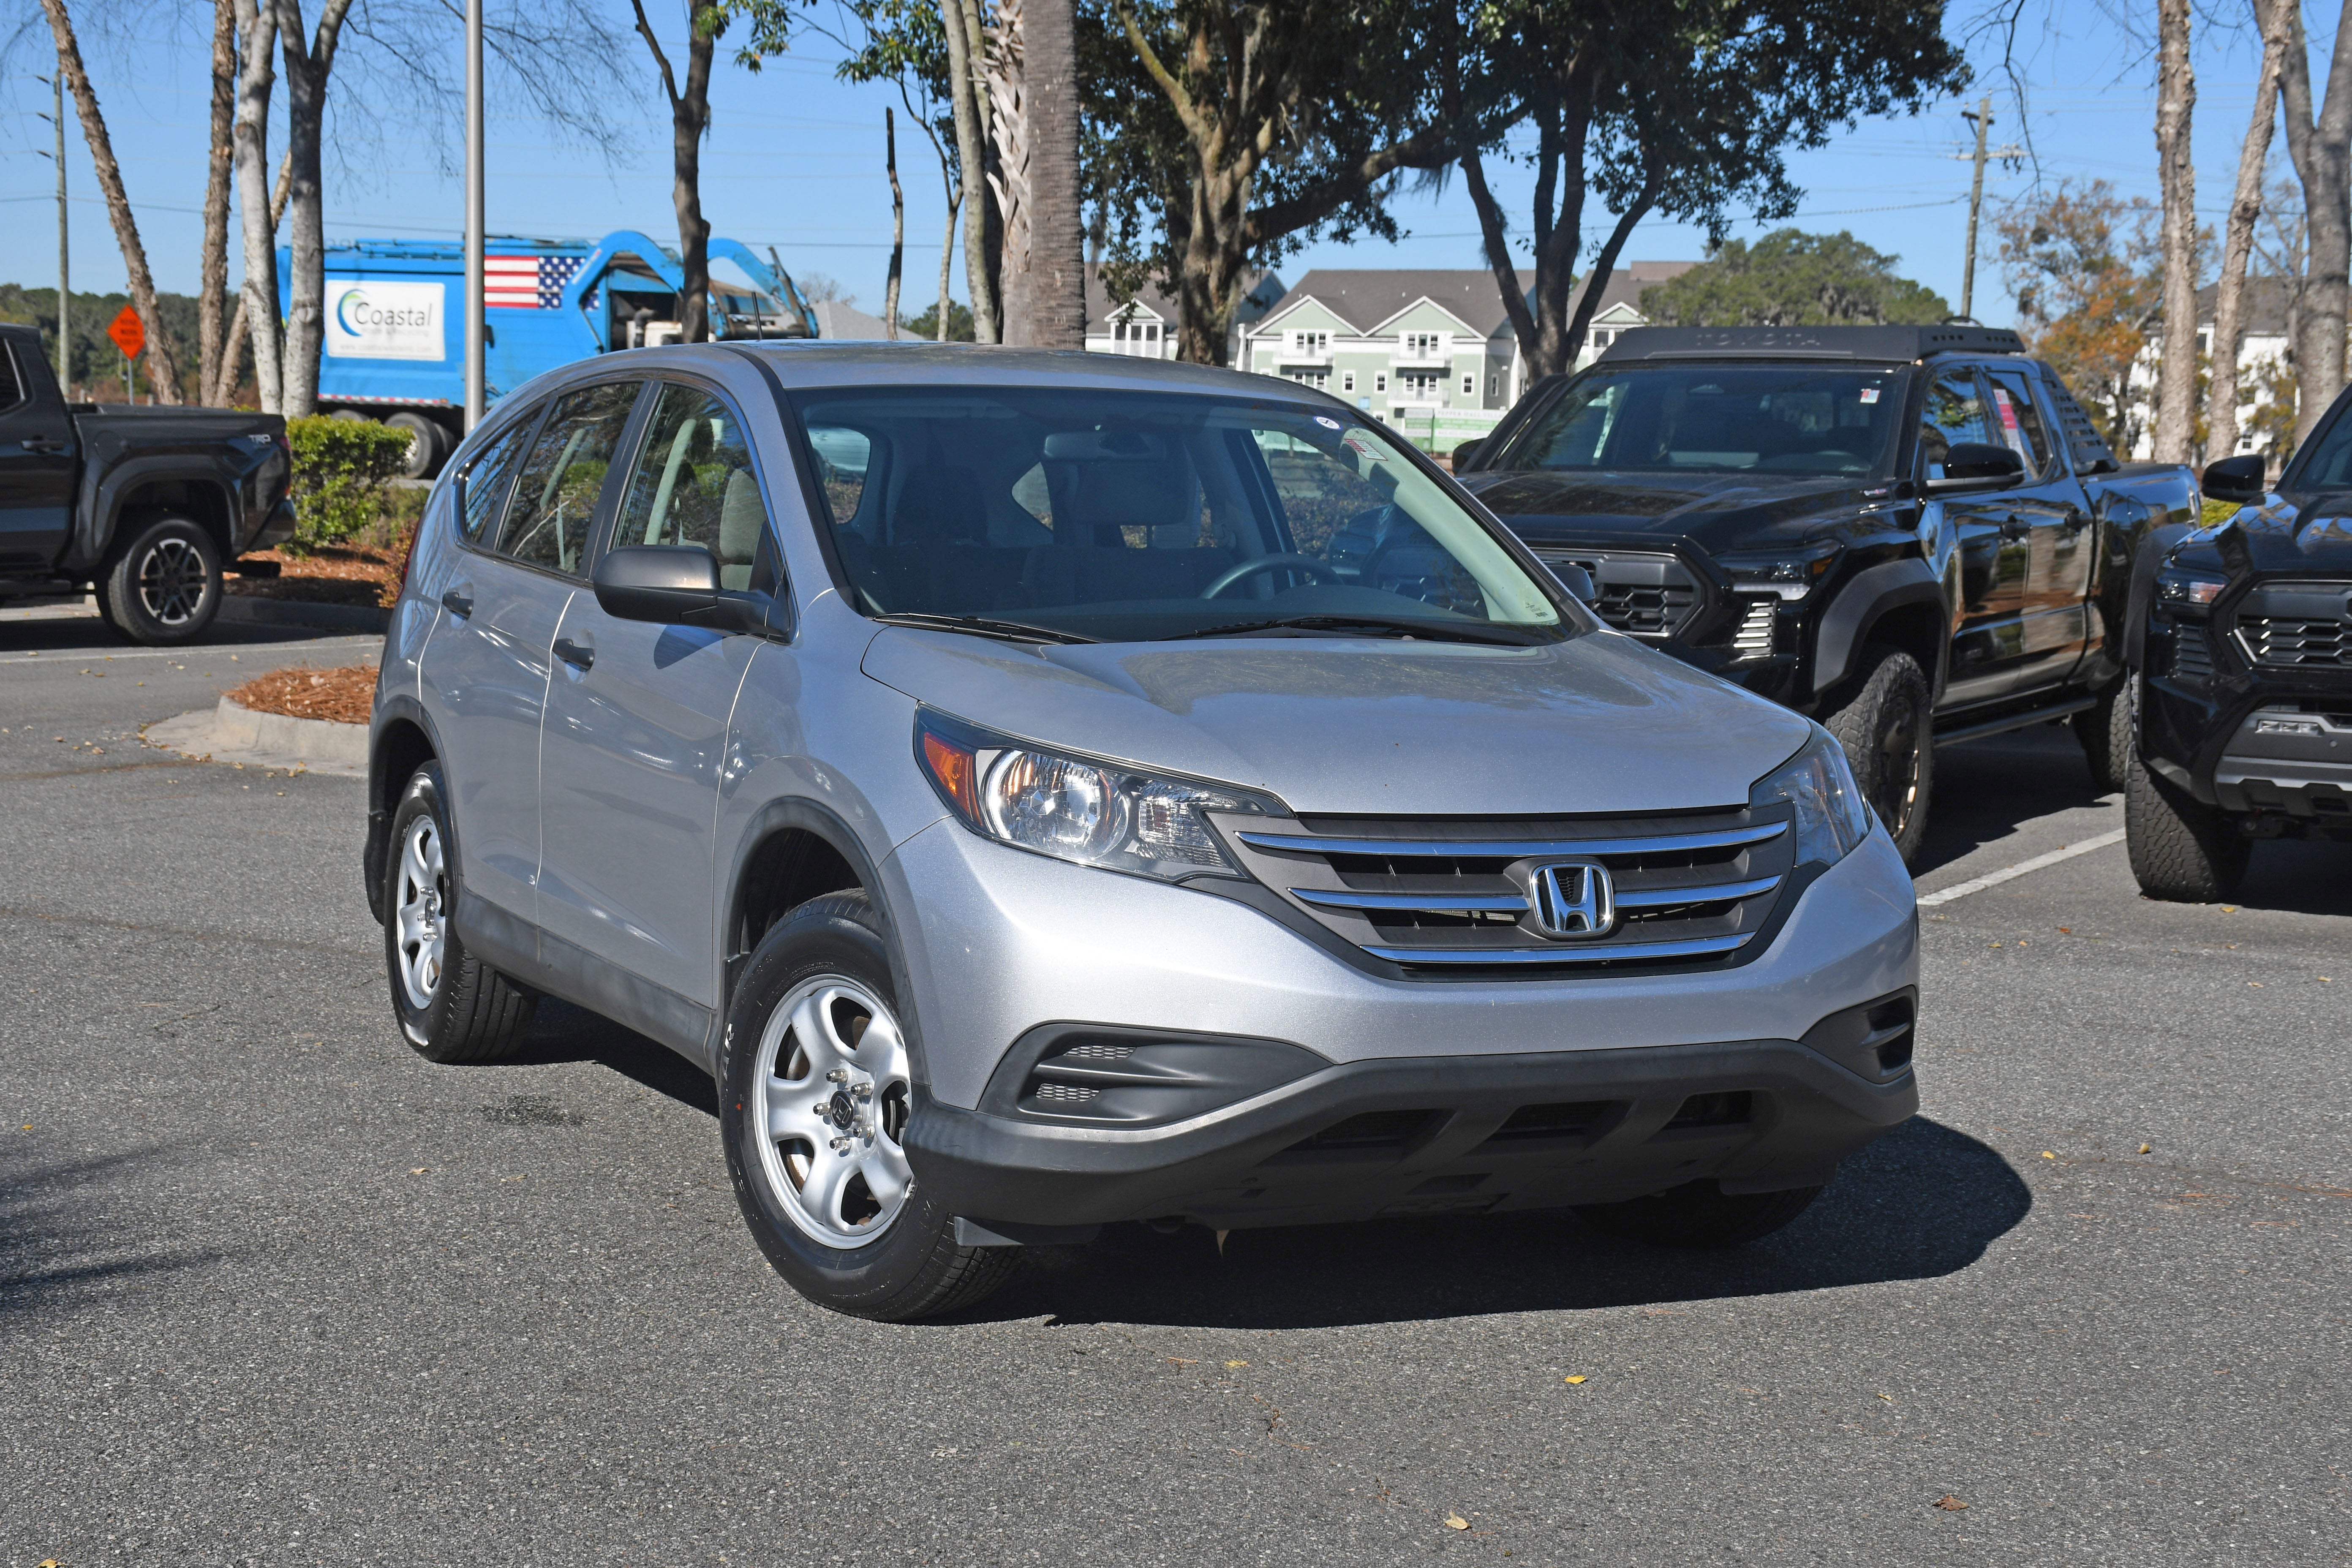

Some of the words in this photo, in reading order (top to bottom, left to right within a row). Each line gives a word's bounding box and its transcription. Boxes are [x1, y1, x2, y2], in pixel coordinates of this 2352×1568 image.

[355, 302, 432, 326] Coastal
[1697, 334, 1821, 346] TOYOTA
[248, 434, 271, 444] TRD
